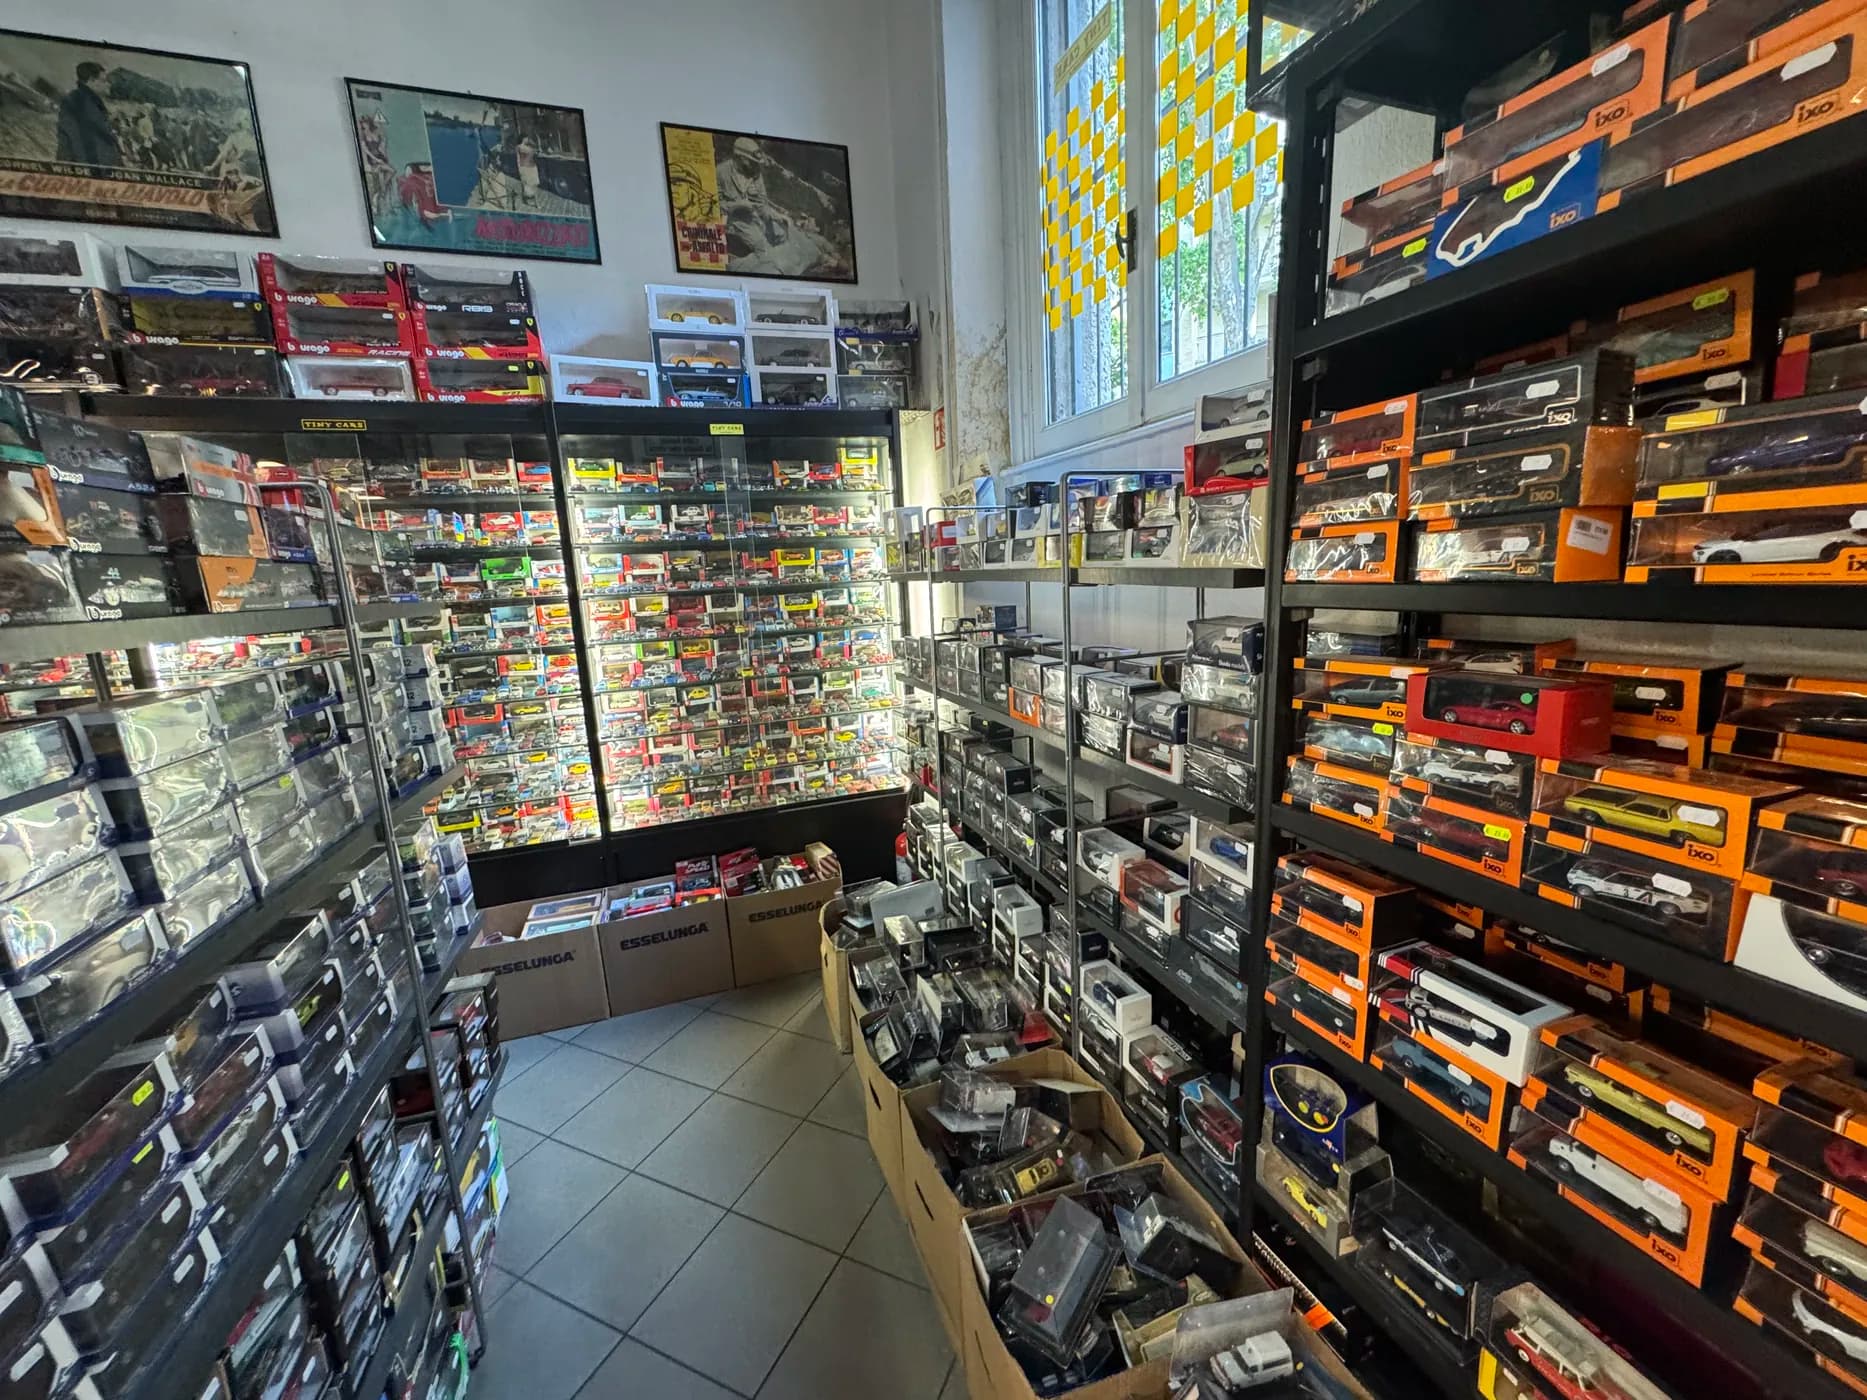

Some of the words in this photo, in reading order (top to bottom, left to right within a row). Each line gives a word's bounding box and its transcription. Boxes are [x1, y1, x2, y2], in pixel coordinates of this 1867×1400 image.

[1595, 107, 1625, 128] ixo
[1798, 102, 1833, 122] ixo
[52, 163, 91, 176] WILDE
[145, 173, 201, 187] WALLACE
[1550, 210, 1576, 228] ixo
[1548, 410, 1572, 423] ixo
[1530, 487, 1555, 501] ixo
[1516, 563, 1536, 574] ixo
[1387, 706, 1404, 718] ixo
[1655, 711, 1677, 724] ixo
[1687, 844, 1715, 862] ixo
[1483, 858, 1503, 874] ixo
[748, 899, 824, 922] ESSELUNGA
[619, 922, 709, 951] ESSELUNGA
[1345, 923, 1359, 937] ixo
[1338, 1035, 1352, 1049] ixo
[1465, 1115, 1483, 1134] ixo
[1676, 1154, 1702, 1177] ixo
[1651, 1239, 1677, 1262] ixo
